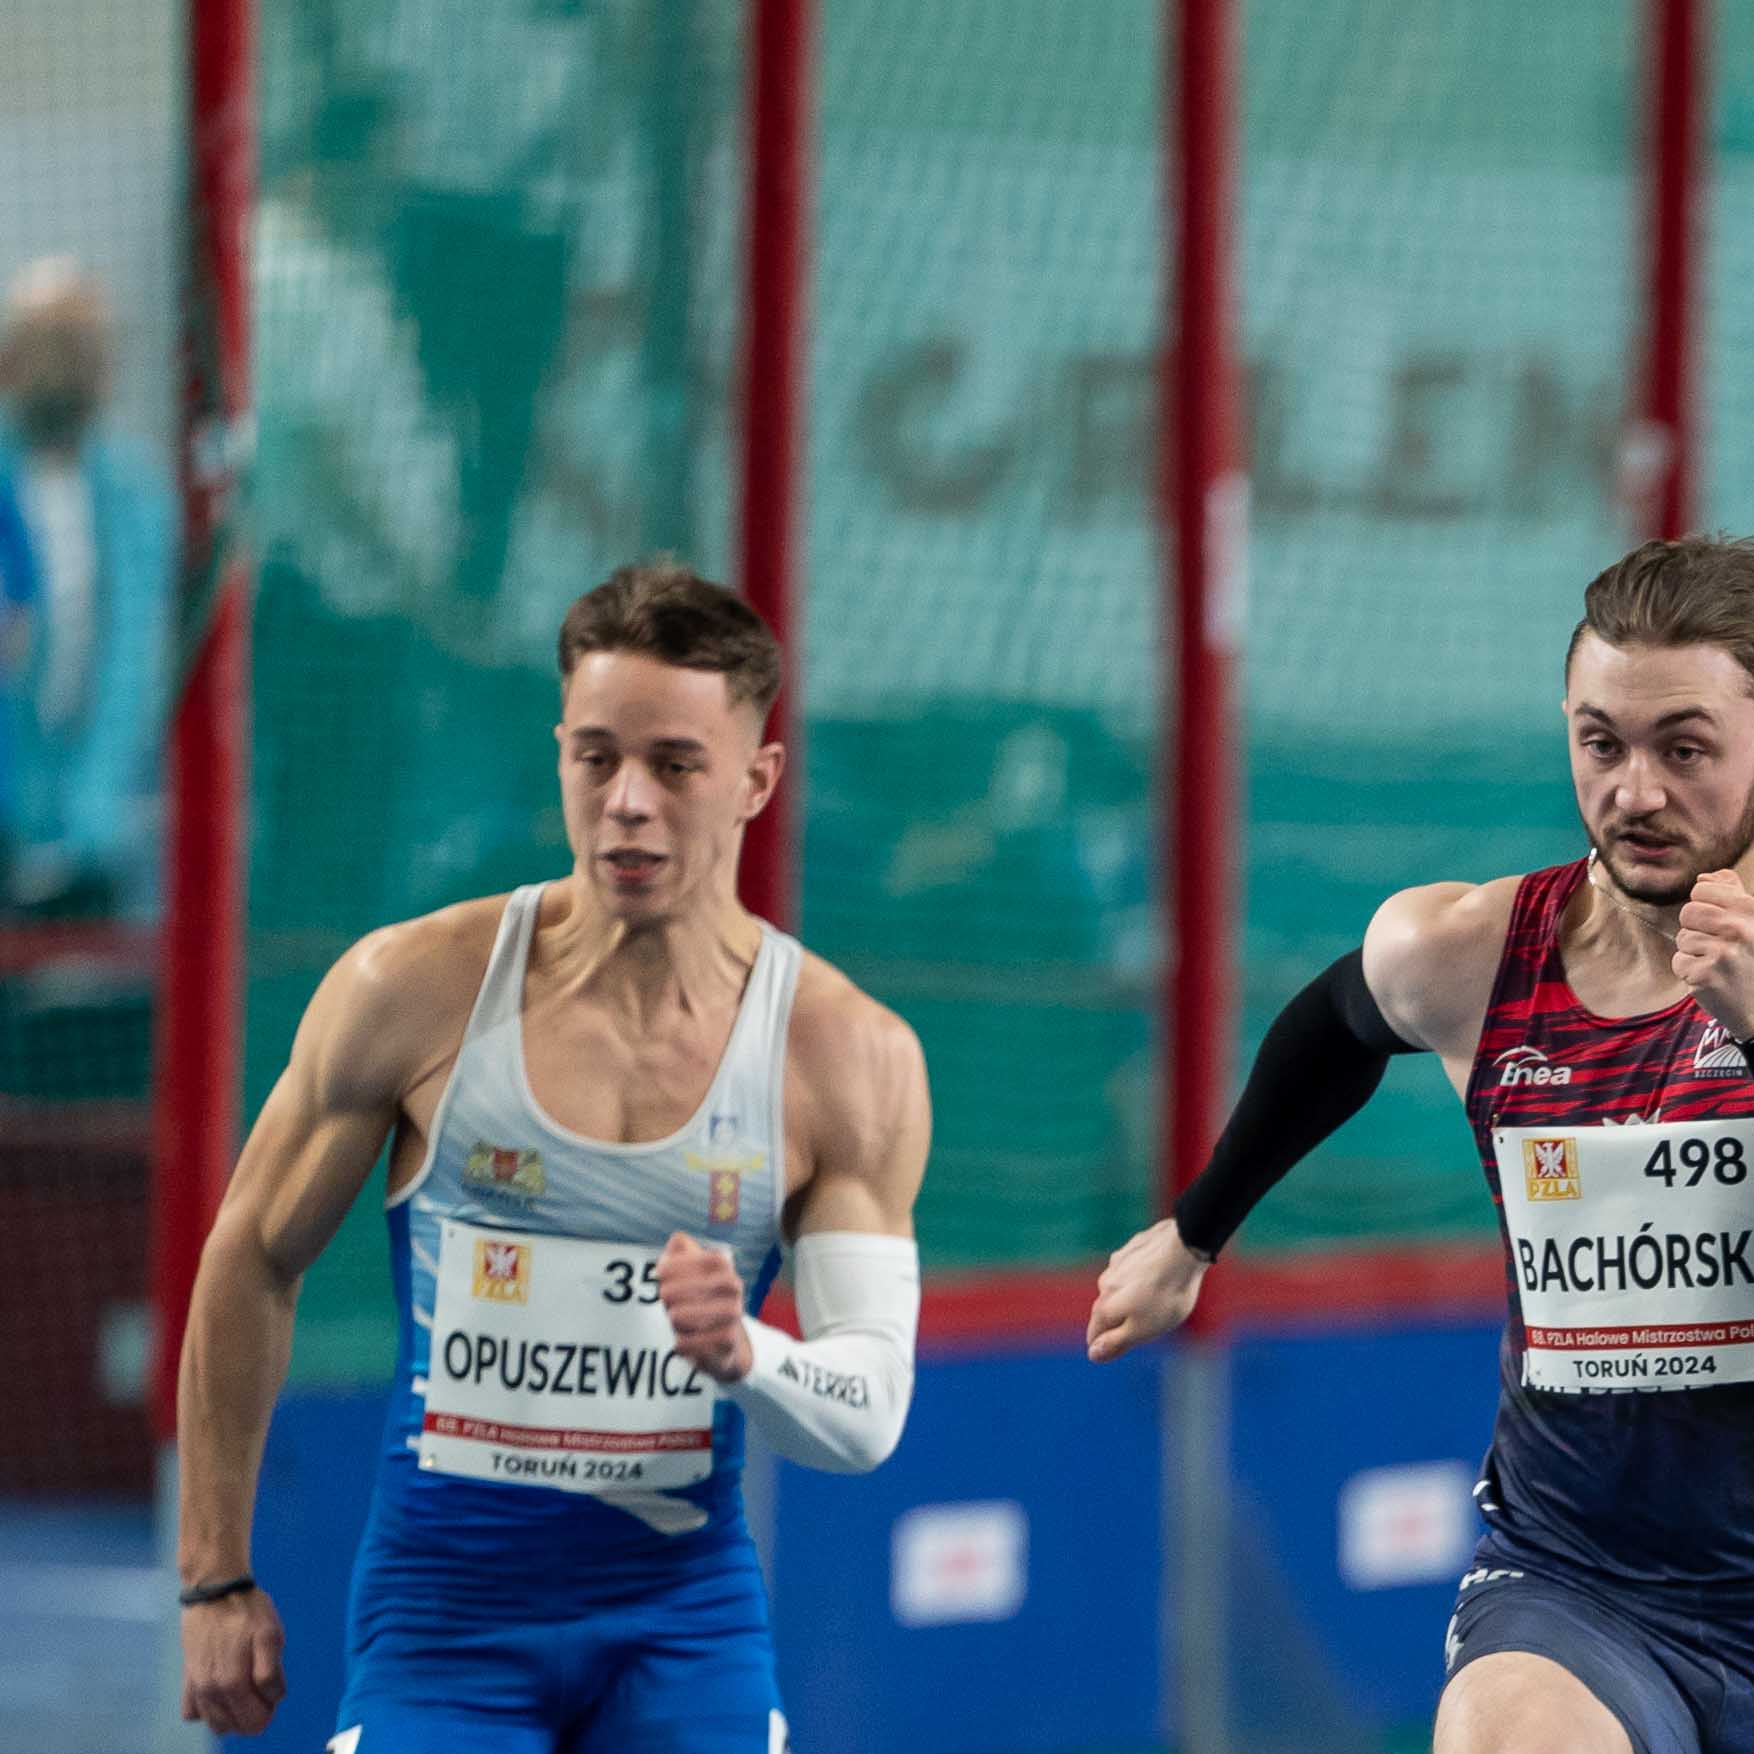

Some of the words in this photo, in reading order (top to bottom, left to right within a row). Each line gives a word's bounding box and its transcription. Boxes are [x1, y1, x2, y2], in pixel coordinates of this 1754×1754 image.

[1643, 1137, 1747, 1187] 498
[603, 1261, 661, 1304] 35
[1576, 1331, 1629, 1345] Halowe
[1632, 1327, 1726, 1343] Mistrzostwa
[445, 1330, 703, 1398] OPUSZEWICZ
[1573, 1353, 1648, 1378] TORUŃ
[1654, 1355, 1717, 1376] 2024
[584, 1461, 643, 1480] 2024
